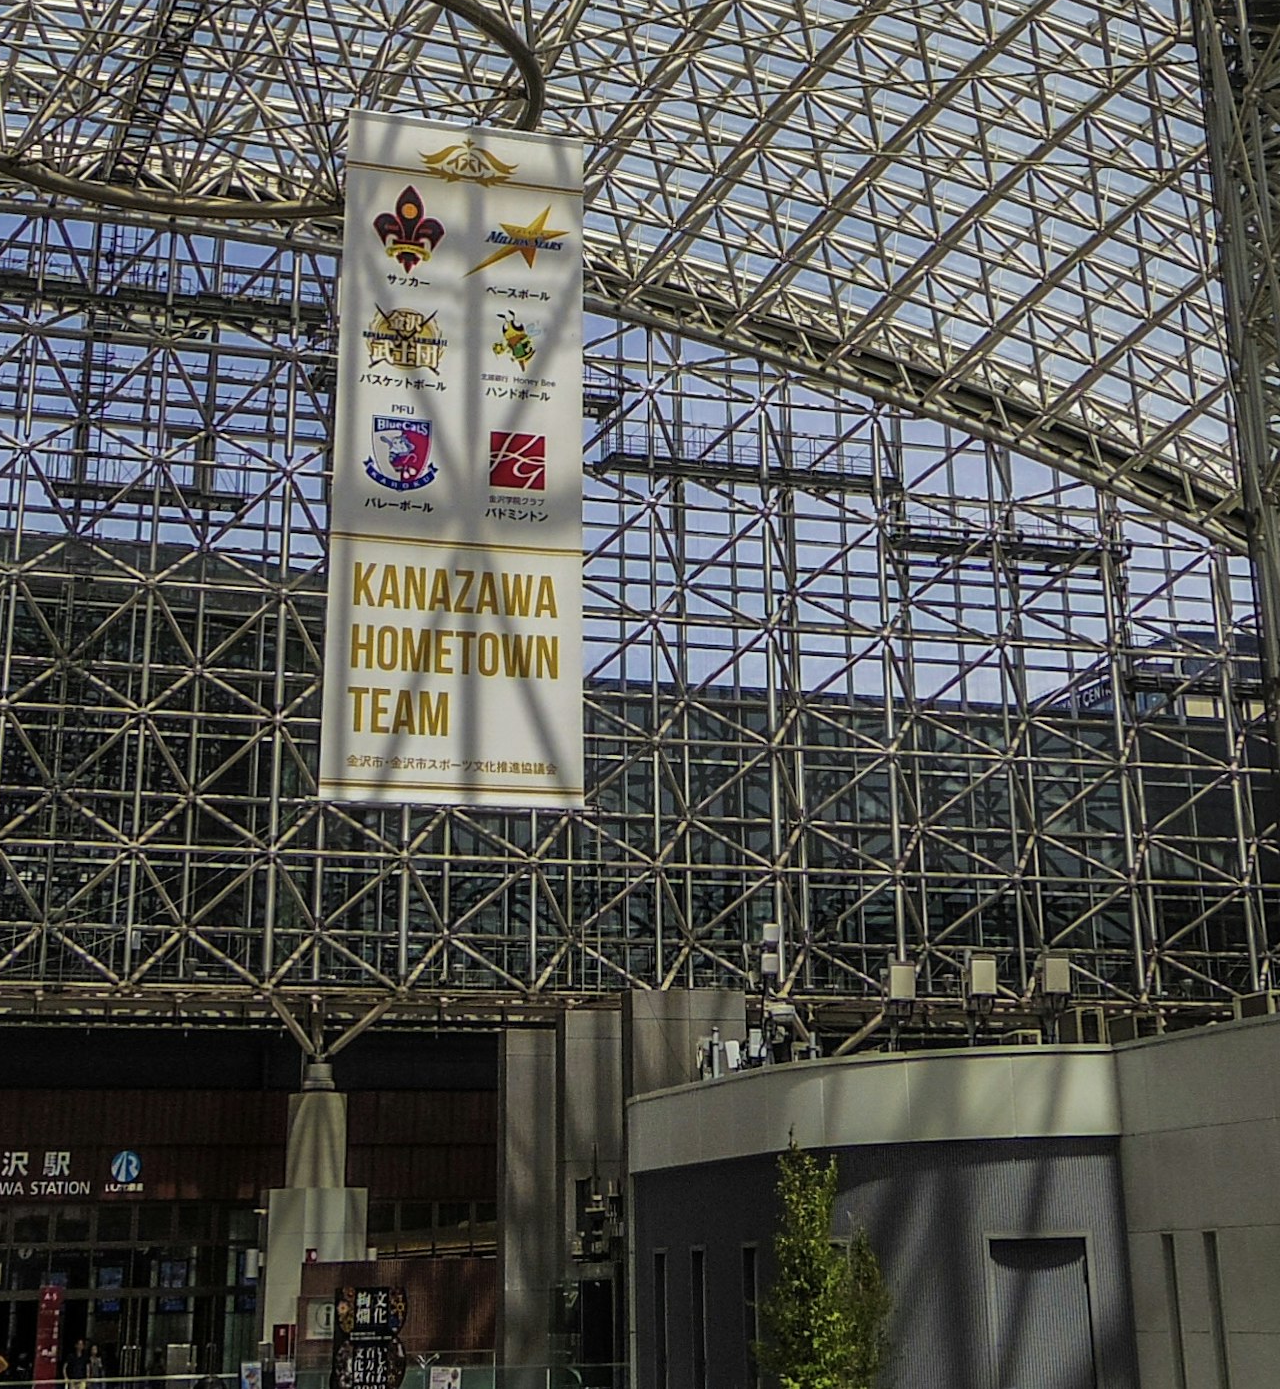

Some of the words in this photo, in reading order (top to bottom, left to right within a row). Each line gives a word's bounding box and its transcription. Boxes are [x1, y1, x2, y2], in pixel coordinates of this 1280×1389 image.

[484, 230, 530, 248] MILLION
[534, 237, 564, 251] STARS
[386, 273, 431, 288] サッカー
[486, 285, 551, 301] ベースボール
[388, 312, 424, 332] 金沢
[371, 339, 439, 369] 武士団
[359, 373, 447, 392] バスケットボール
[513, 376, 539, 387] Honey
[540, 378, 557, 388] Bee
[485, 387, 551, 402] ハンドボール
[391, 404, 415, 415] PFU
[364, 497, 434, 513] バレーボール
[484, 507, 549, 522] バドミントン
[353, 561, 558, 619] KANAZAWA
[350, 623, 559, 680] HOMETOWN
[347, 686, 449, 737] TEAM
[346, 753, 558, 776] 金沢市・金沢市スポーツ文化推進協議会
[29, 1180, 91, 1196] STATION
[373, 1290, 388, 1324] 文化
